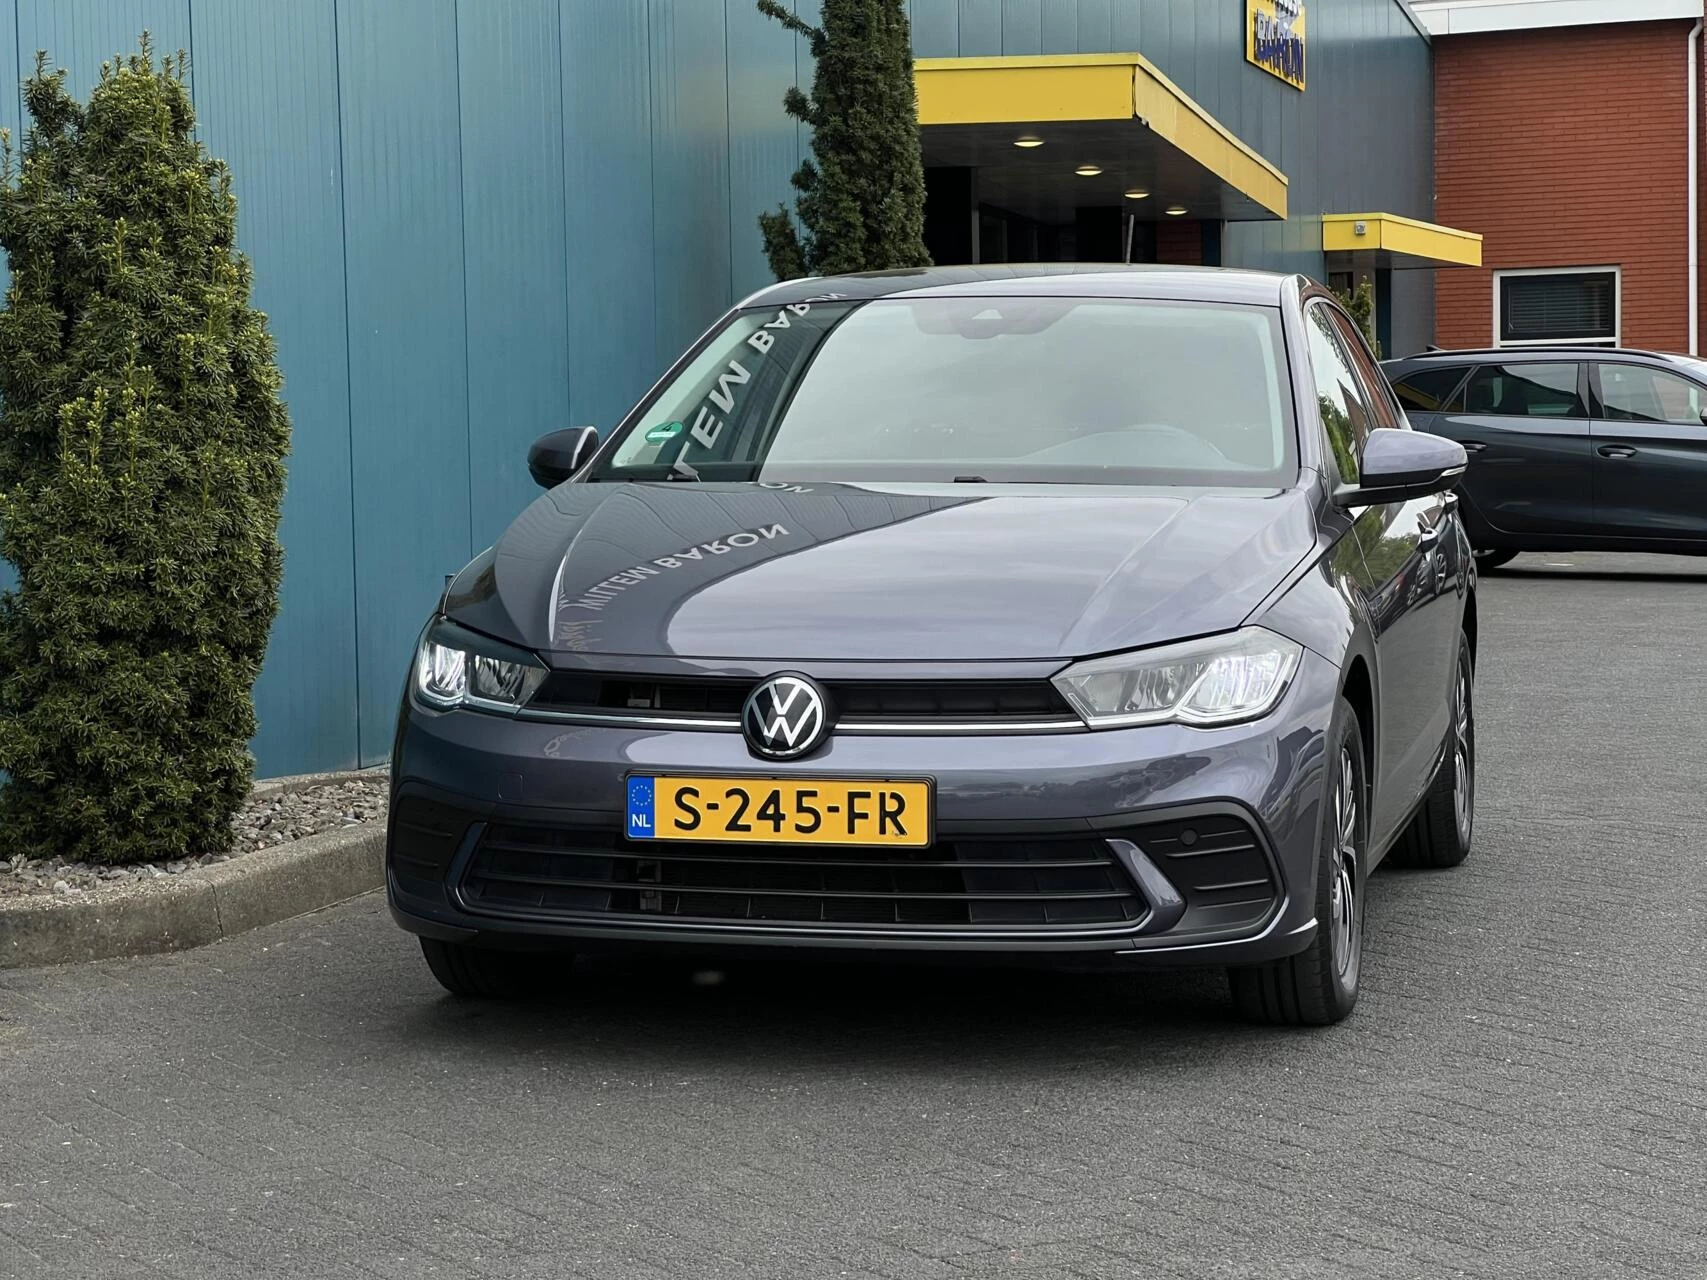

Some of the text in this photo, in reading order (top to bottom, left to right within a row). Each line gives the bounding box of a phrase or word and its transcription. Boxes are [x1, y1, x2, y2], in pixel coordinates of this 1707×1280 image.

[748, 679, 819, 748] VW
[631, 786, 908, 836] NL S-245-FR
